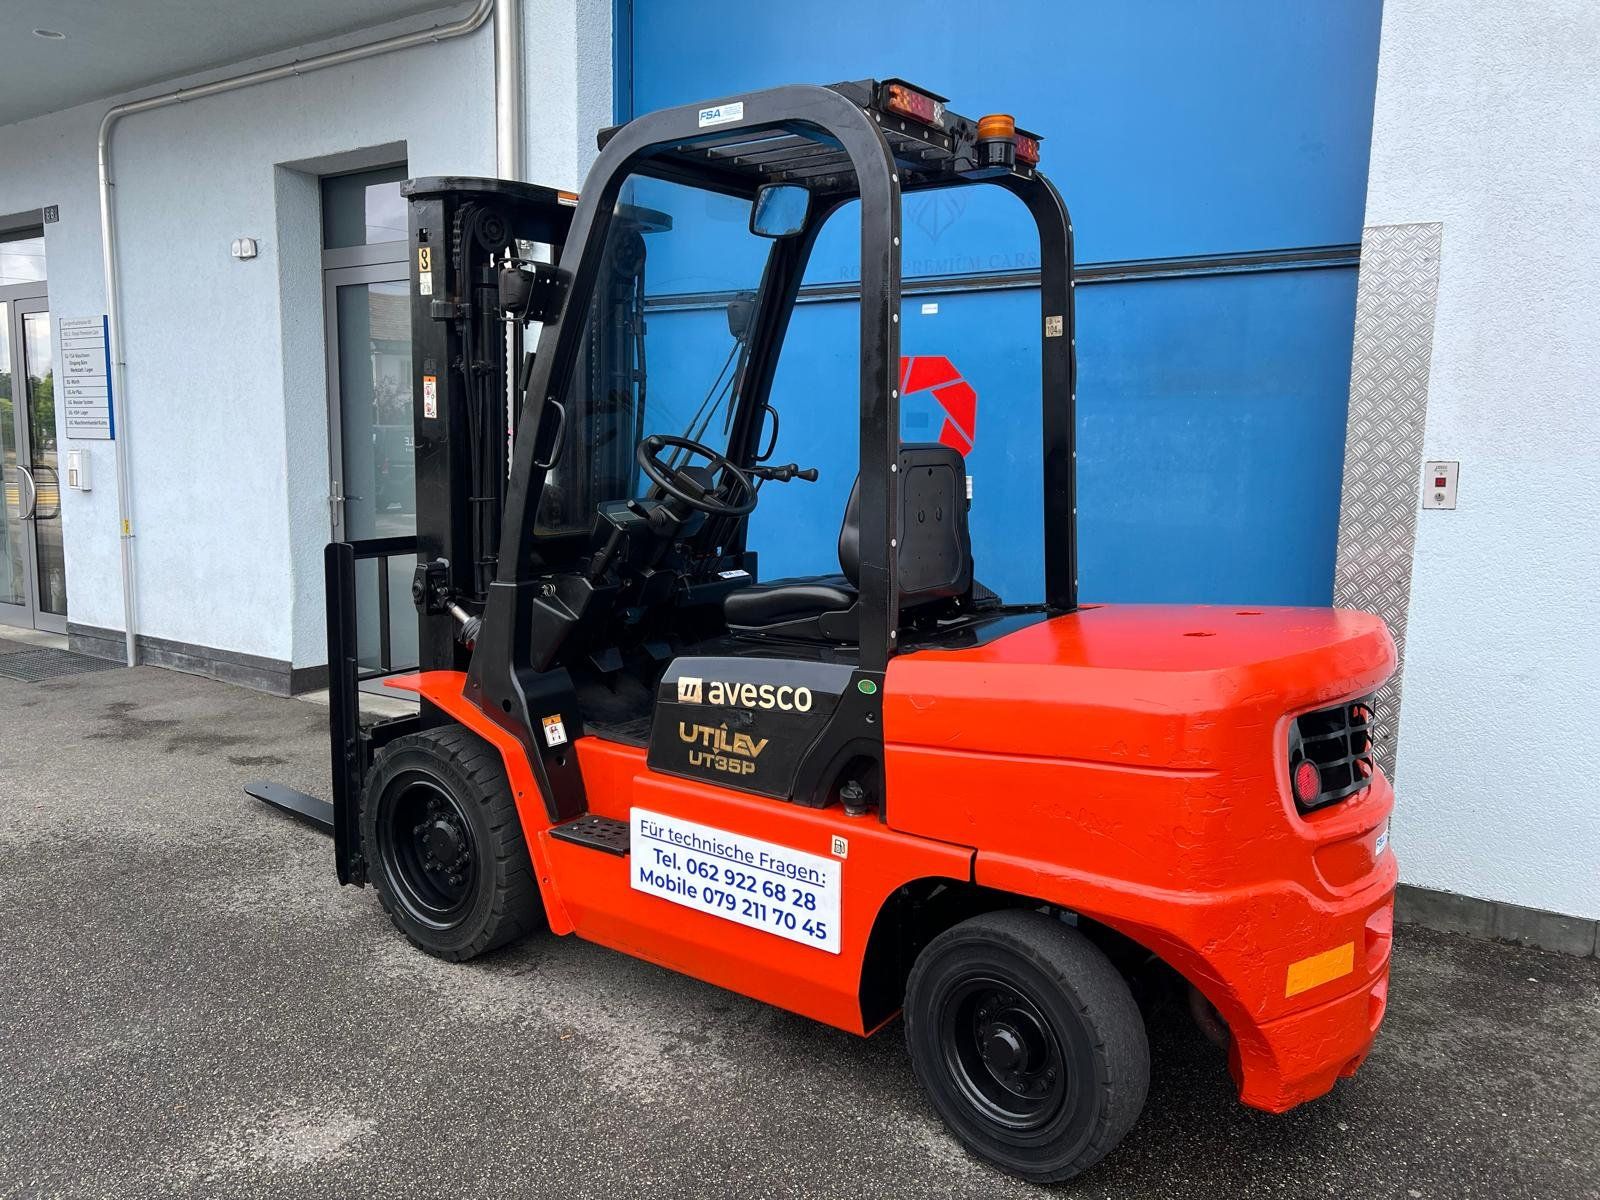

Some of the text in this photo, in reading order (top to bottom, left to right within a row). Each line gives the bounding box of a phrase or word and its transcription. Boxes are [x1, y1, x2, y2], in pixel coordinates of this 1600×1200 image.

[700, 109, 721, 120] FSA
[988, 252, 1040, 269] CARS
[708, 681, 812, 712] avesco
[679, 721, 769, 758] UTILEV
[689, 750, 756, 775] UT35P
[640, 819, 826, 885] Für technische Fragen:
[653, 847, 816, 911] Tel. 062 922 68 28
[640, 867, 827, 940] Mobile 079 211 70 45
